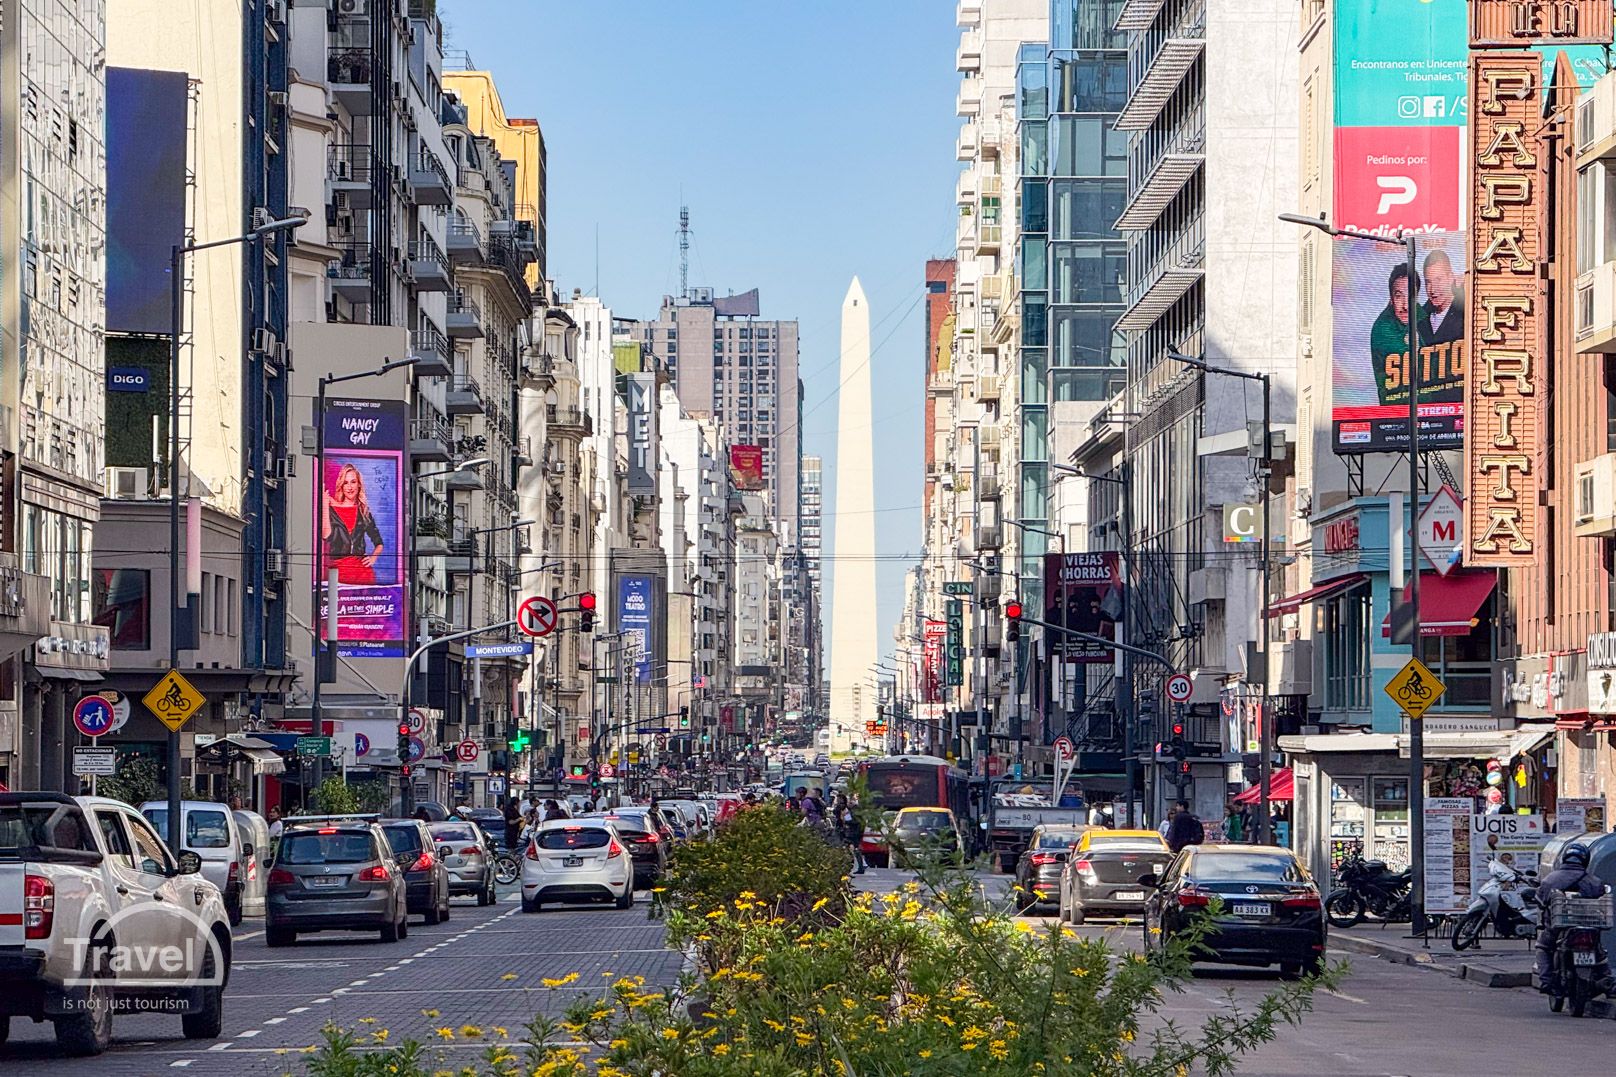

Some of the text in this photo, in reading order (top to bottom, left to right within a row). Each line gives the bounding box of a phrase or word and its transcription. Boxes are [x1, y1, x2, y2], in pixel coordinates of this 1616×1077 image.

[1511, 2, 1577, 35] DE LA
[1351, 59, 1409, 69] Encontranos
[1410, 60, 1425, 69] en:
[1404, 72, 1454, 82] Tribunales,
[1367, 155, 1428, 166] Pedinos por:
[341, 418, 380, 432] NANCY
[631, 385, 650, 468] MET
[349, 431, 372, 445] GAY
[1230, 506, 1255, 535] C
[1433, 520, 1455, 541] M
[365, 604, 394, 615] SIMPLE
[475, 645, 524, 655] MONTEVIDEO
[1171, 682, 1188, 694] 30
